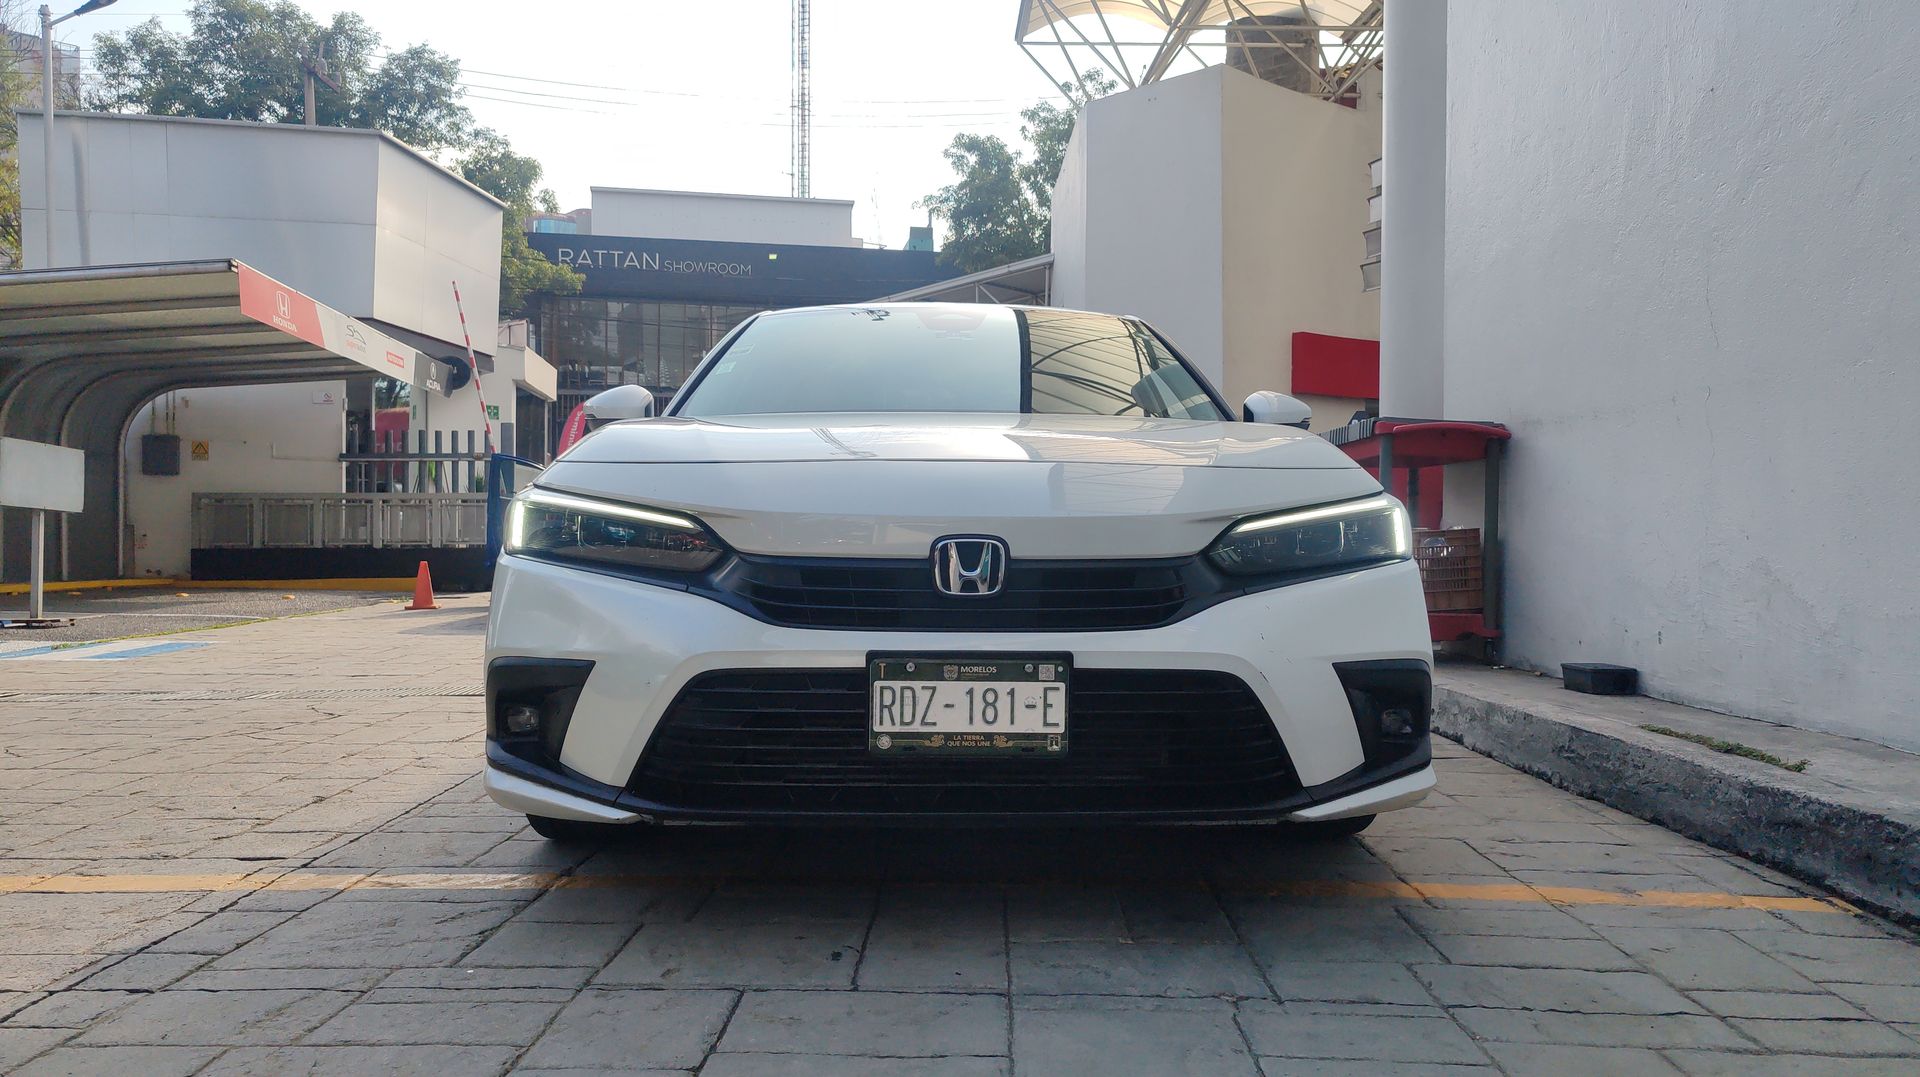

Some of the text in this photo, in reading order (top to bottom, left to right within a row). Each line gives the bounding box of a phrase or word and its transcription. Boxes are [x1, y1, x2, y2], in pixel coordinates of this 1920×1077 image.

[558, 248, 752, 276] RATTAN SHOWROOM
[273, 315, 297, 332] HONDA
[426, 379, 441, 391] ACURA
[879, 685, 1060, 727] RDZ-181-E
